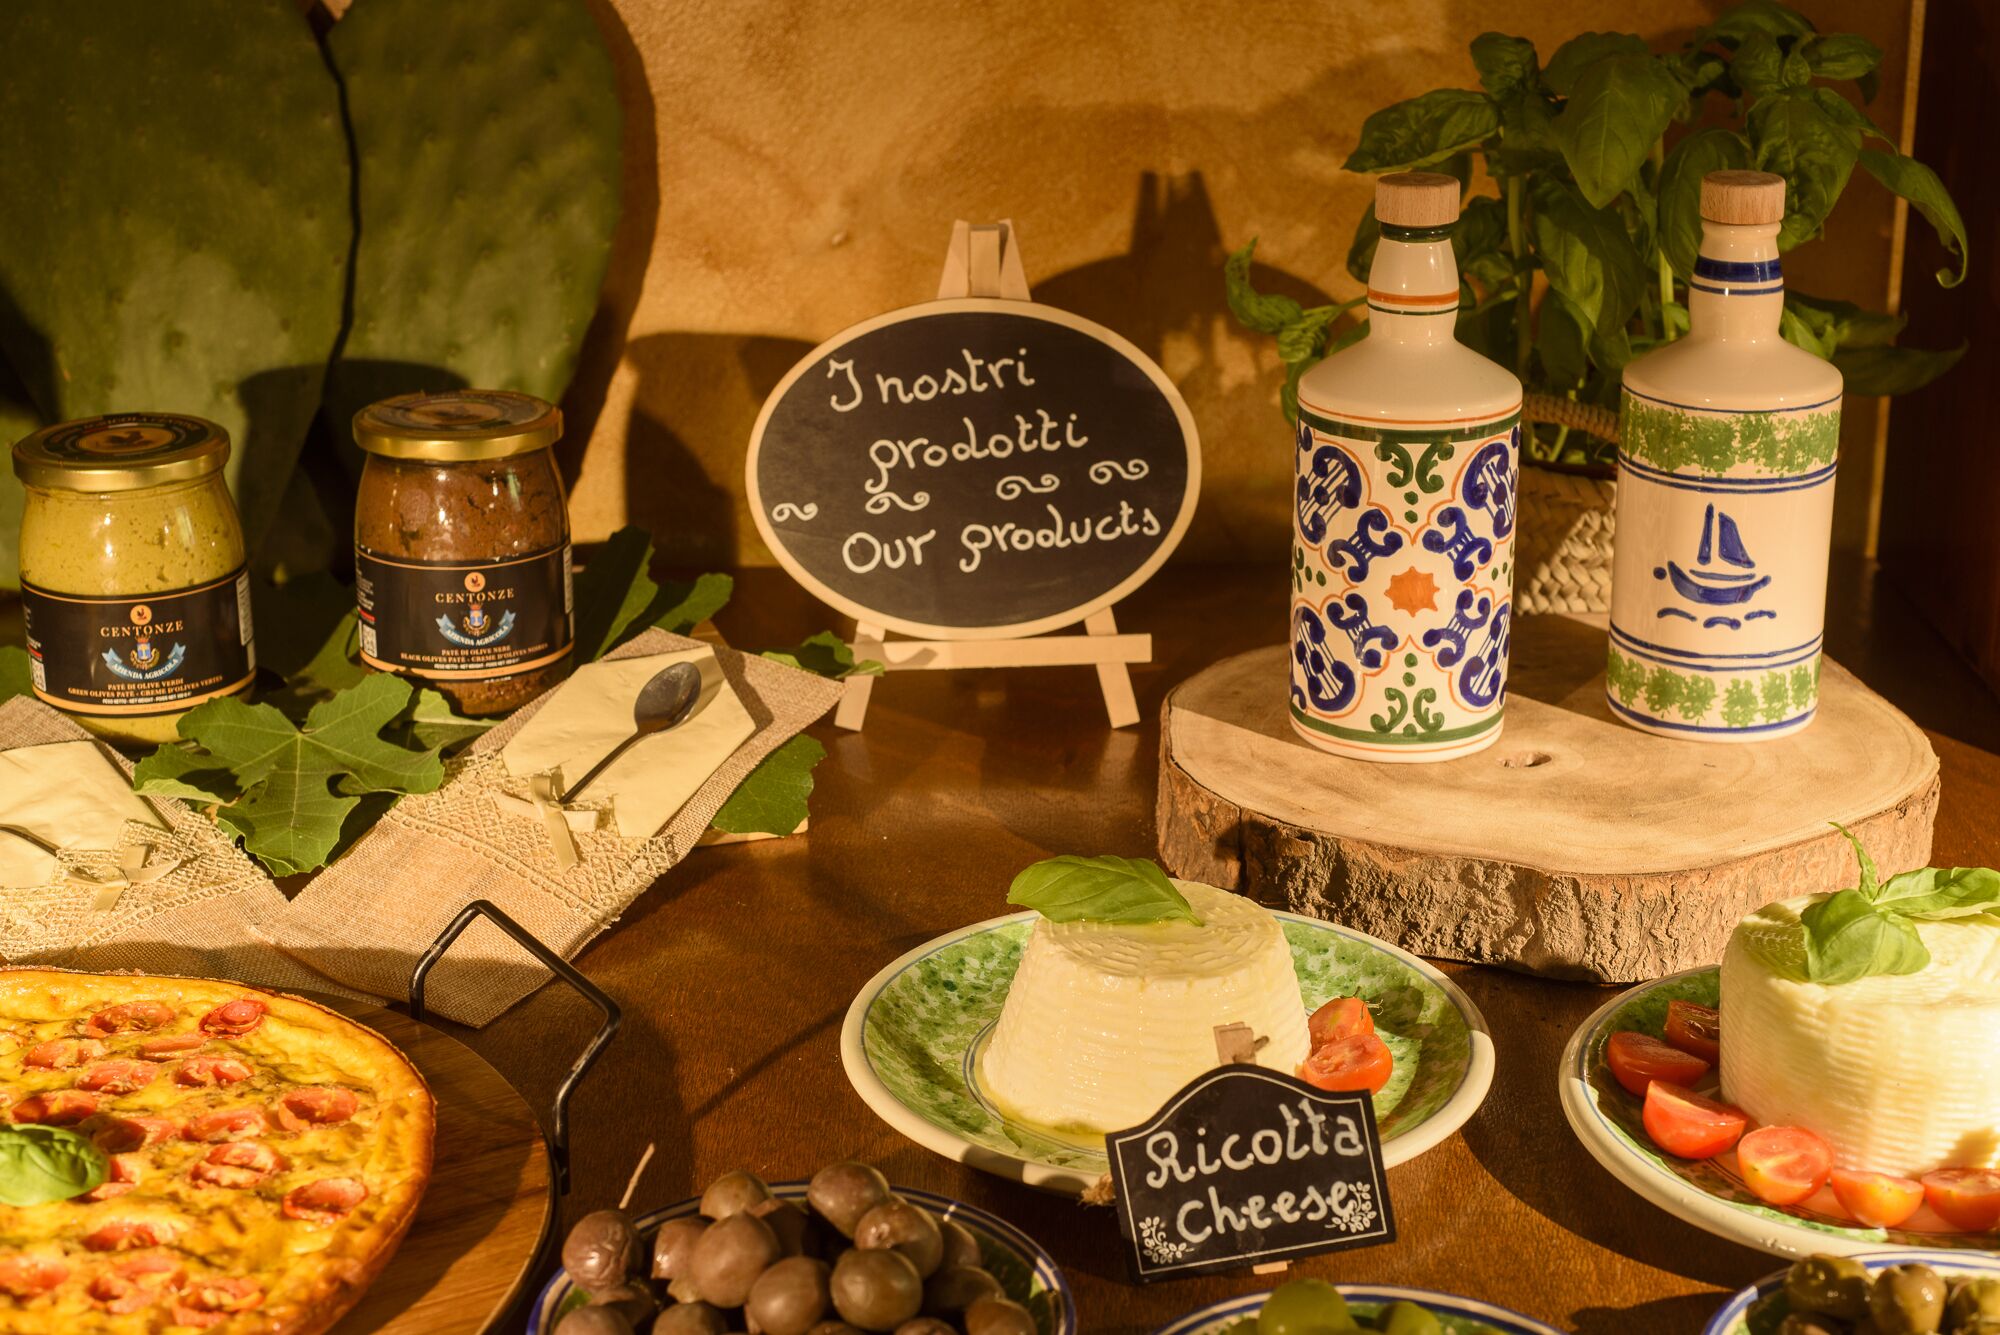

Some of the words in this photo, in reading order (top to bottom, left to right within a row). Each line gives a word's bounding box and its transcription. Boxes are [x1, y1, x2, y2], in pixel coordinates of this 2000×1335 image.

[876, 348, 1035, 403] nostri
[865, 409, 1088, 494] prodotti
[842, 530, 936, 574] Our
[959, 501, 1161, 573] products
[435, 588, 514, 603] CENTONZE
[100, 621, 184, 637] CENTONZE
[112, 663, 143, 679] AZIENDA
[144, 659, 178, 679] AGRICOLA
[1146, 1099, 1364, 1188] Ricotta
[1176, 1181, 1352, 1243] Cheese
